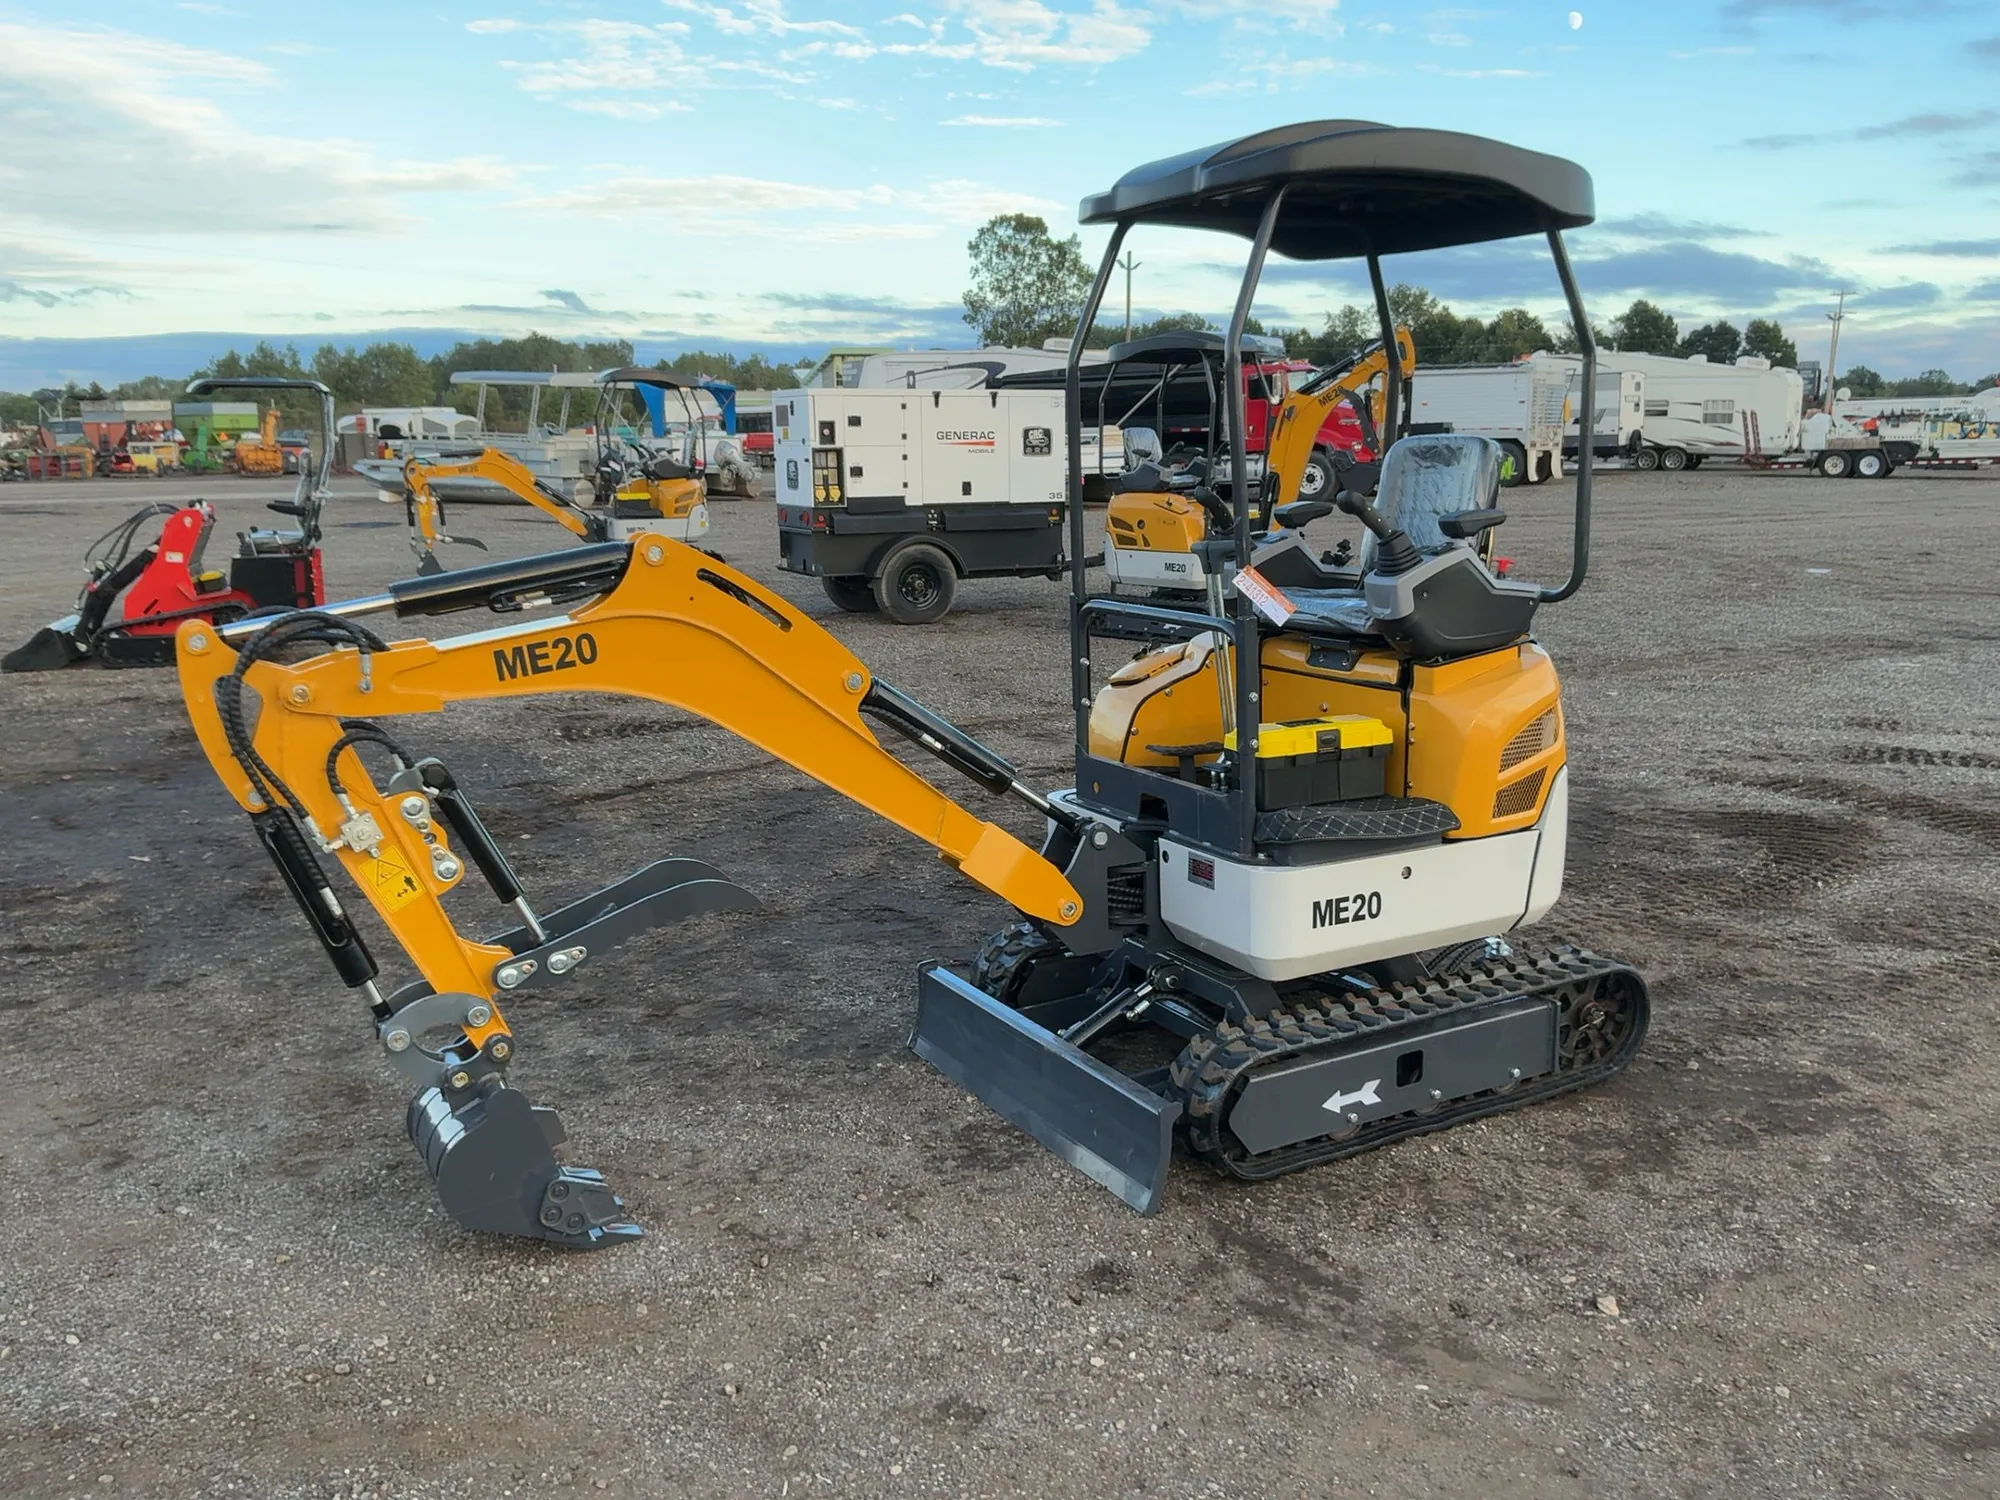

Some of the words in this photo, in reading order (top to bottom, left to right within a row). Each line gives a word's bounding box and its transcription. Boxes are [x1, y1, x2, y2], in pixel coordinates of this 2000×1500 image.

[936, 431, 995, 440] GENERAC
[1164, 562, 1186, 573] ME20
[1235, 575, 1268, 607] 2-41312
[493, 633, 597, 682] ME20
[1312, 891, 1382, 929] ME20
